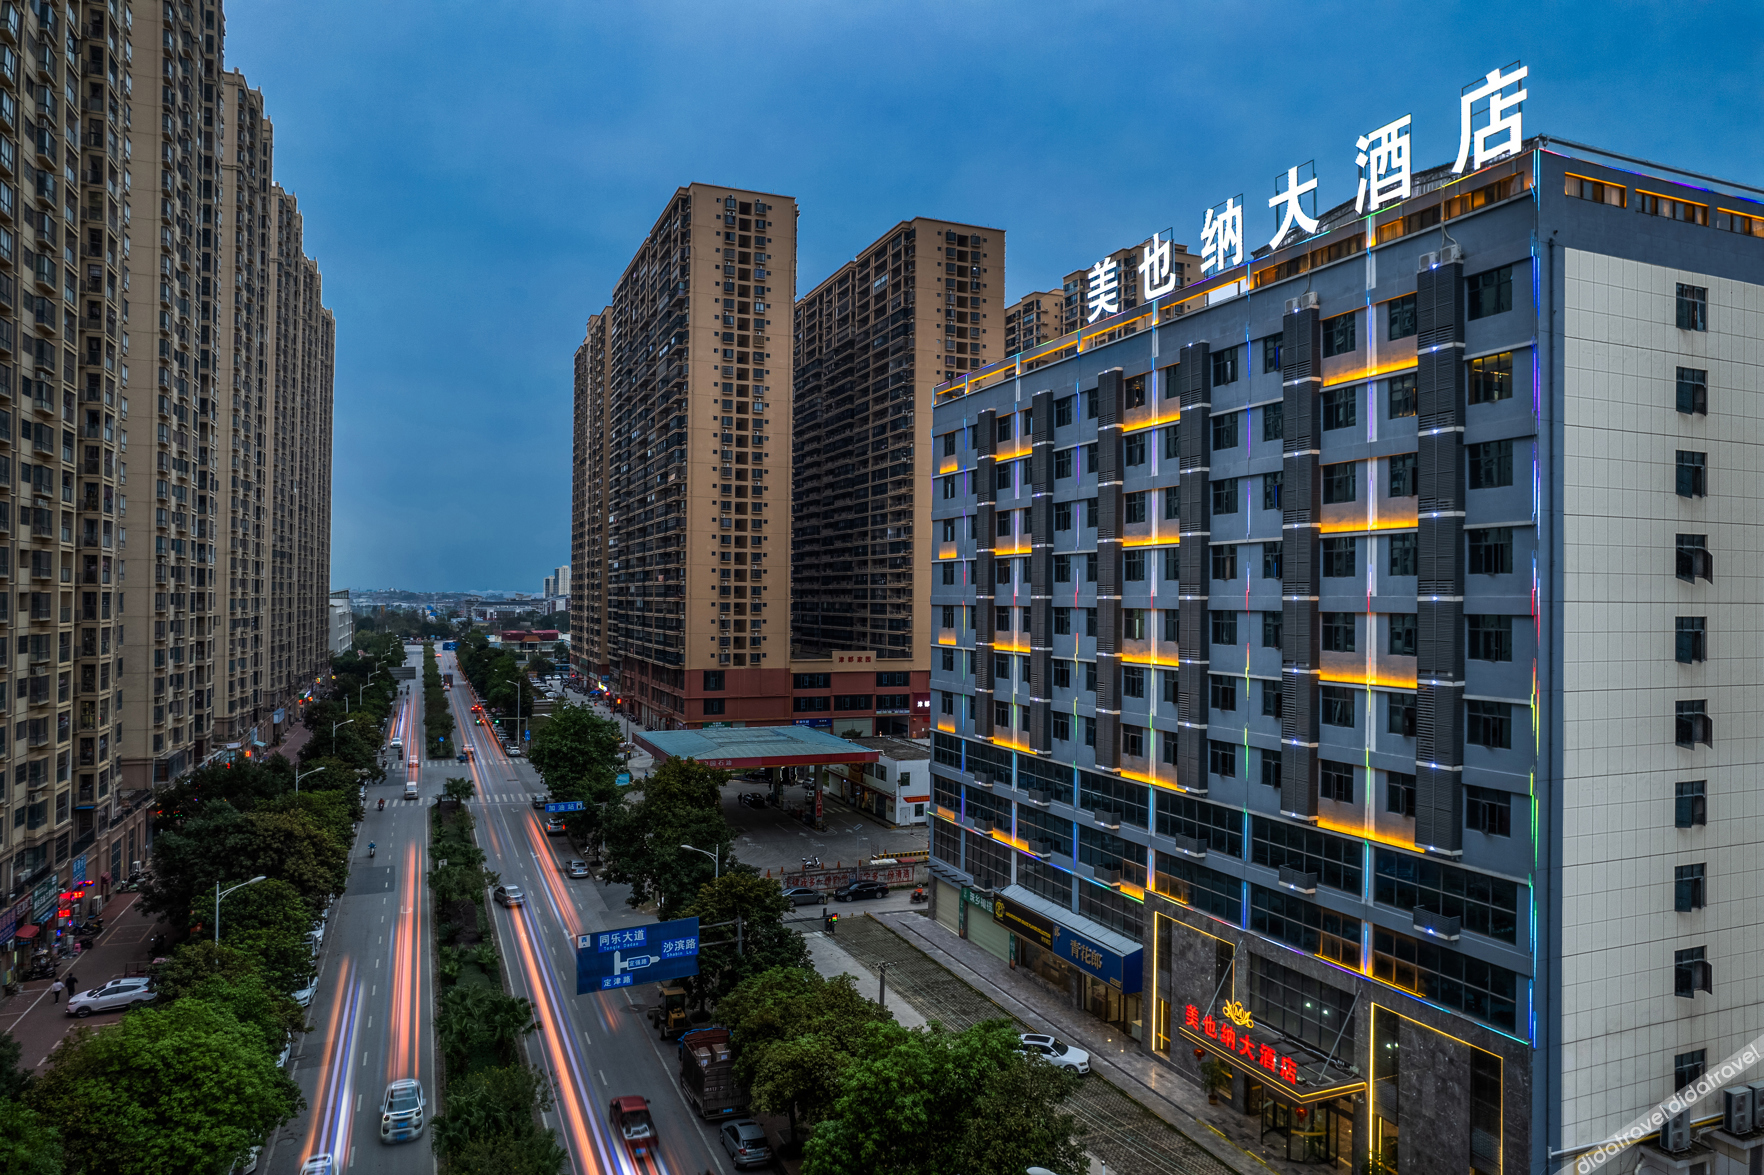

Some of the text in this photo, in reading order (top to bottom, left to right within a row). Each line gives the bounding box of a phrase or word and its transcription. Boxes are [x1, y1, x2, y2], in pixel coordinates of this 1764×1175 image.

[1087, 66, 1528, 323] 美也纳大酒店
[548, 803, 575, 812] 加油站
[599, 928, 645, 947] 同乐大道
[663, 937, 696, 953] 沙滨路
[1070, 939, 1103, 970] 青花郎
[1185, 1003, 1297, 1085] 美也纳大酒店
